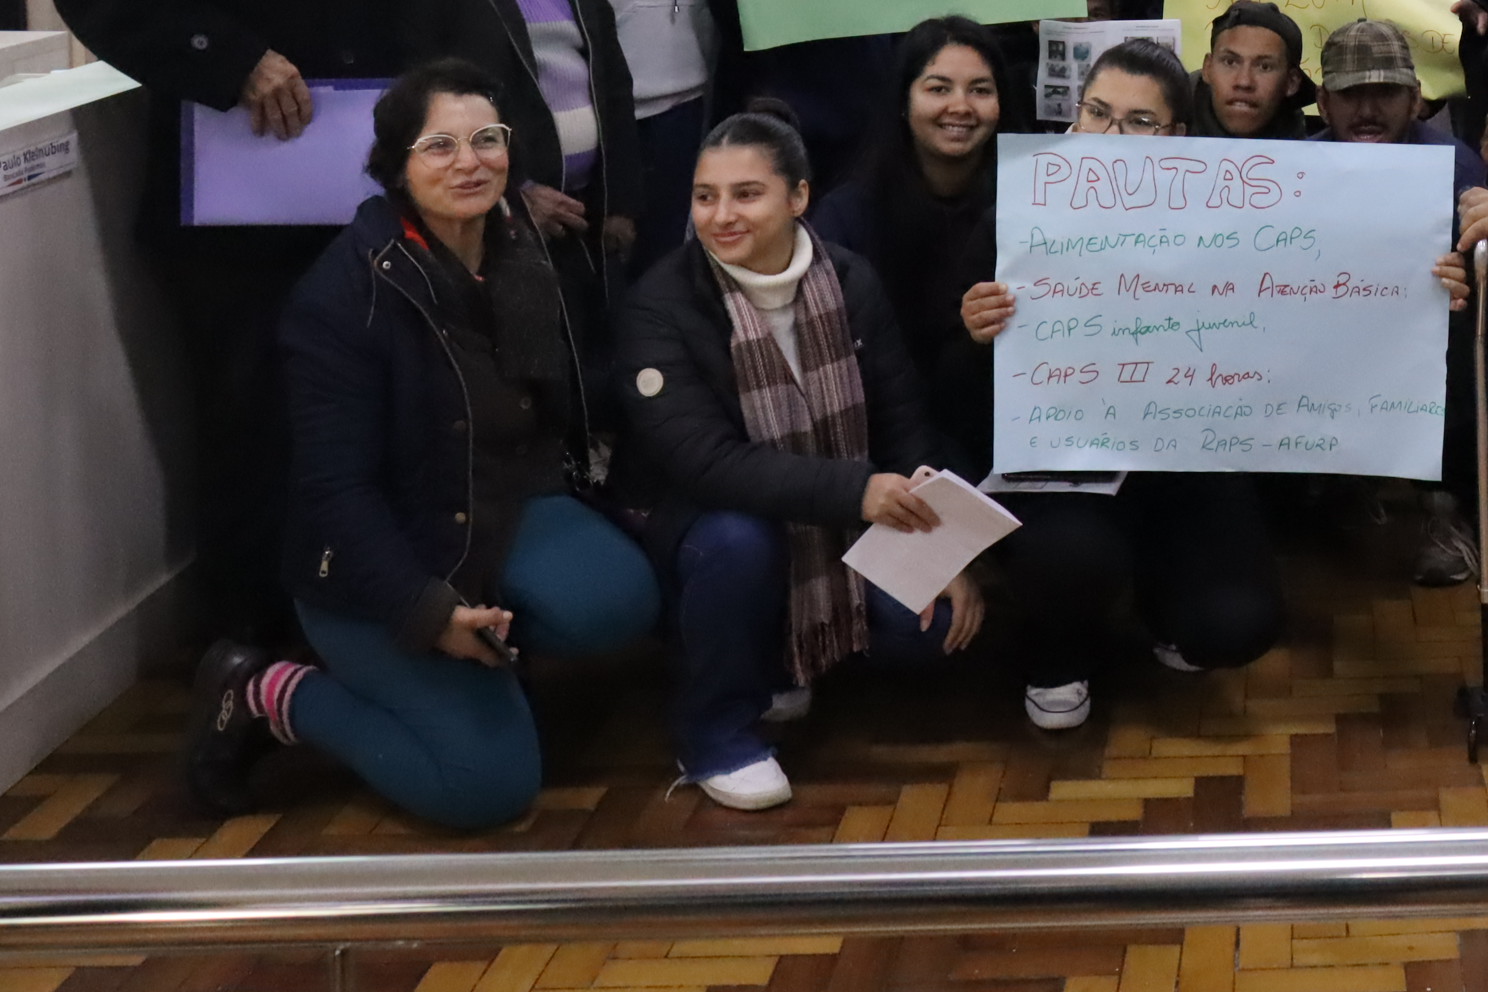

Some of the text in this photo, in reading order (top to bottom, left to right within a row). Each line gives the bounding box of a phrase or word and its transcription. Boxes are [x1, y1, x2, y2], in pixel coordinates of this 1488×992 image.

[1197, 232, 1241, 249] NOS
[1030, 275, 1104, 300] SAÚDE
[1118, 273, 1197, 301] MENTAL
[1211, 282, 1236, 297] NA
[1257, 271, 1327, 303] ATENÇÃO
[1035, 314, 1103, 341] CAPS
[1111, 316, 1181, 346] infanto
[1165, 366, 1196, 386] 24
[1028, 405, 1085, 424] APOIO
[1264, 403, 1288, 419] DE
[1029, 435, 1039, 449] E
[1152, 437, 1178, 453] DA
[1200, 427, 1256, 454] RAPS
